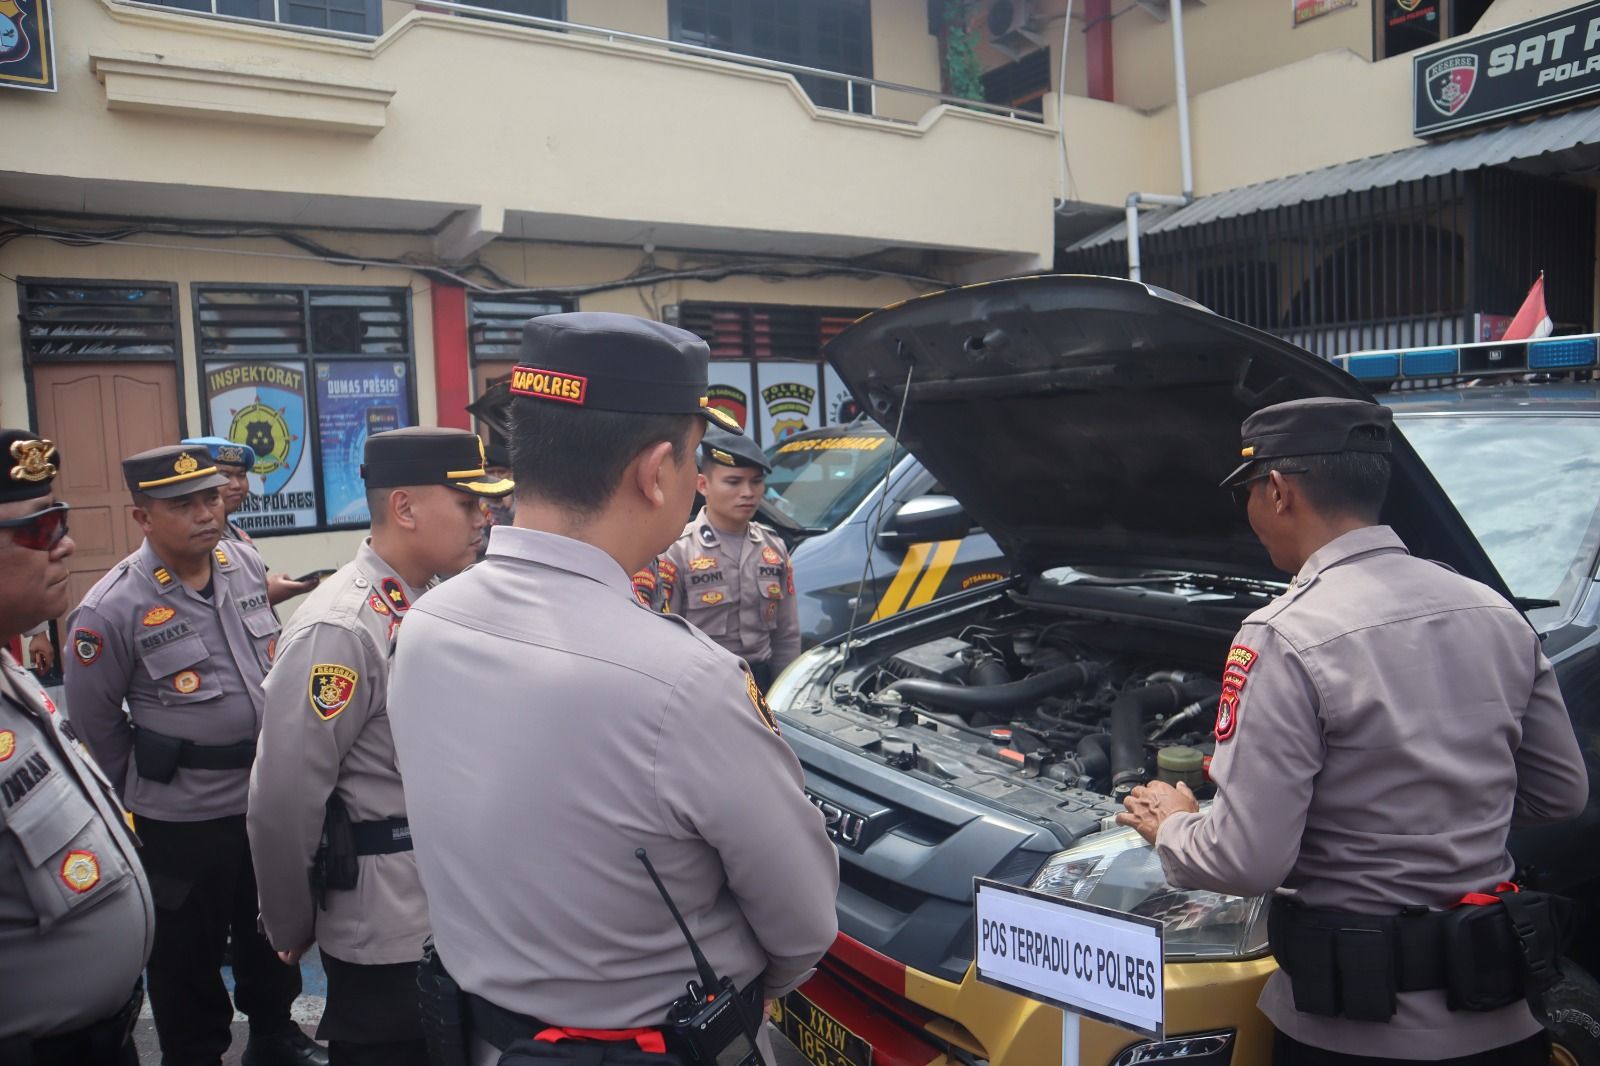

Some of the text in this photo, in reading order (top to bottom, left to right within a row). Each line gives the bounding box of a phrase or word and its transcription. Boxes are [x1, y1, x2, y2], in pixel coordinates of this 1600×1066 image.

[1487, 24, 1576, 78] SAT
[210, 366, 300, 391] INSPEKTORAT
[327, 380, 360, 394] DUMAS
[512, 370, 581, 399] KAPOLRES
[262, 491, 315, 512] POLRES
[239, 513, 296, 530] TARAKAN
[691, 571, 724, 585] DONI
[982, 918, 1156, 1000] POS TERPADU CC POLRES
